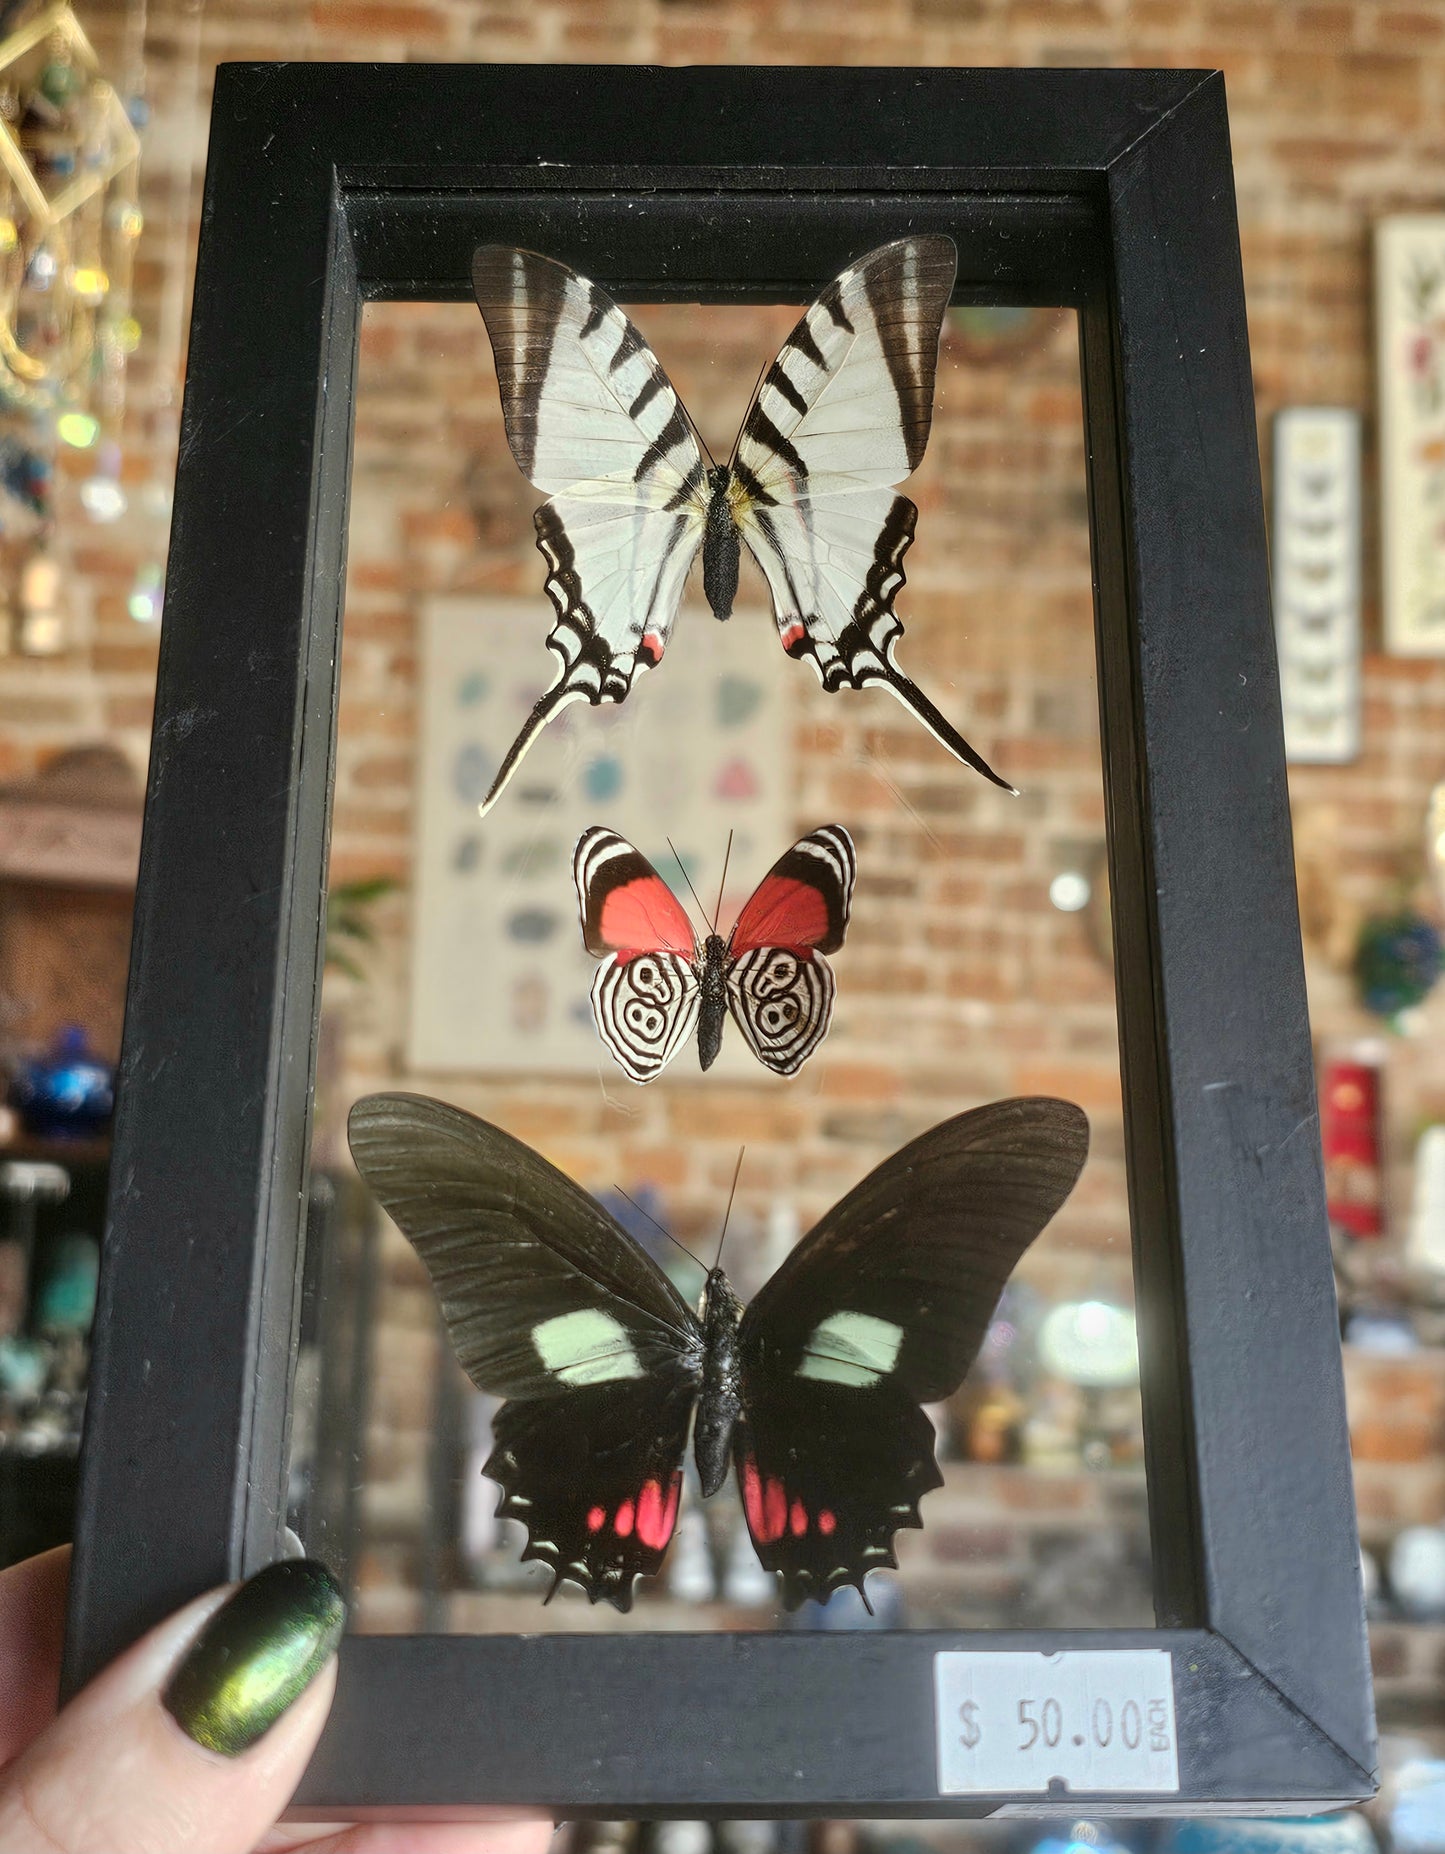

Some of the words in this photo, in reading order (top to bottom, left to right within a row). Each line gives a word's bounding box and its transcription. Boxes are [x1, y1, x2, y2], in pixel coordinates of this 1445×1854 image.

[958, 1699, 981, 1749] $
[1017, 1698, 1141, 1750] 50.00
[1148, 1698, 1170, 1751] EACH
